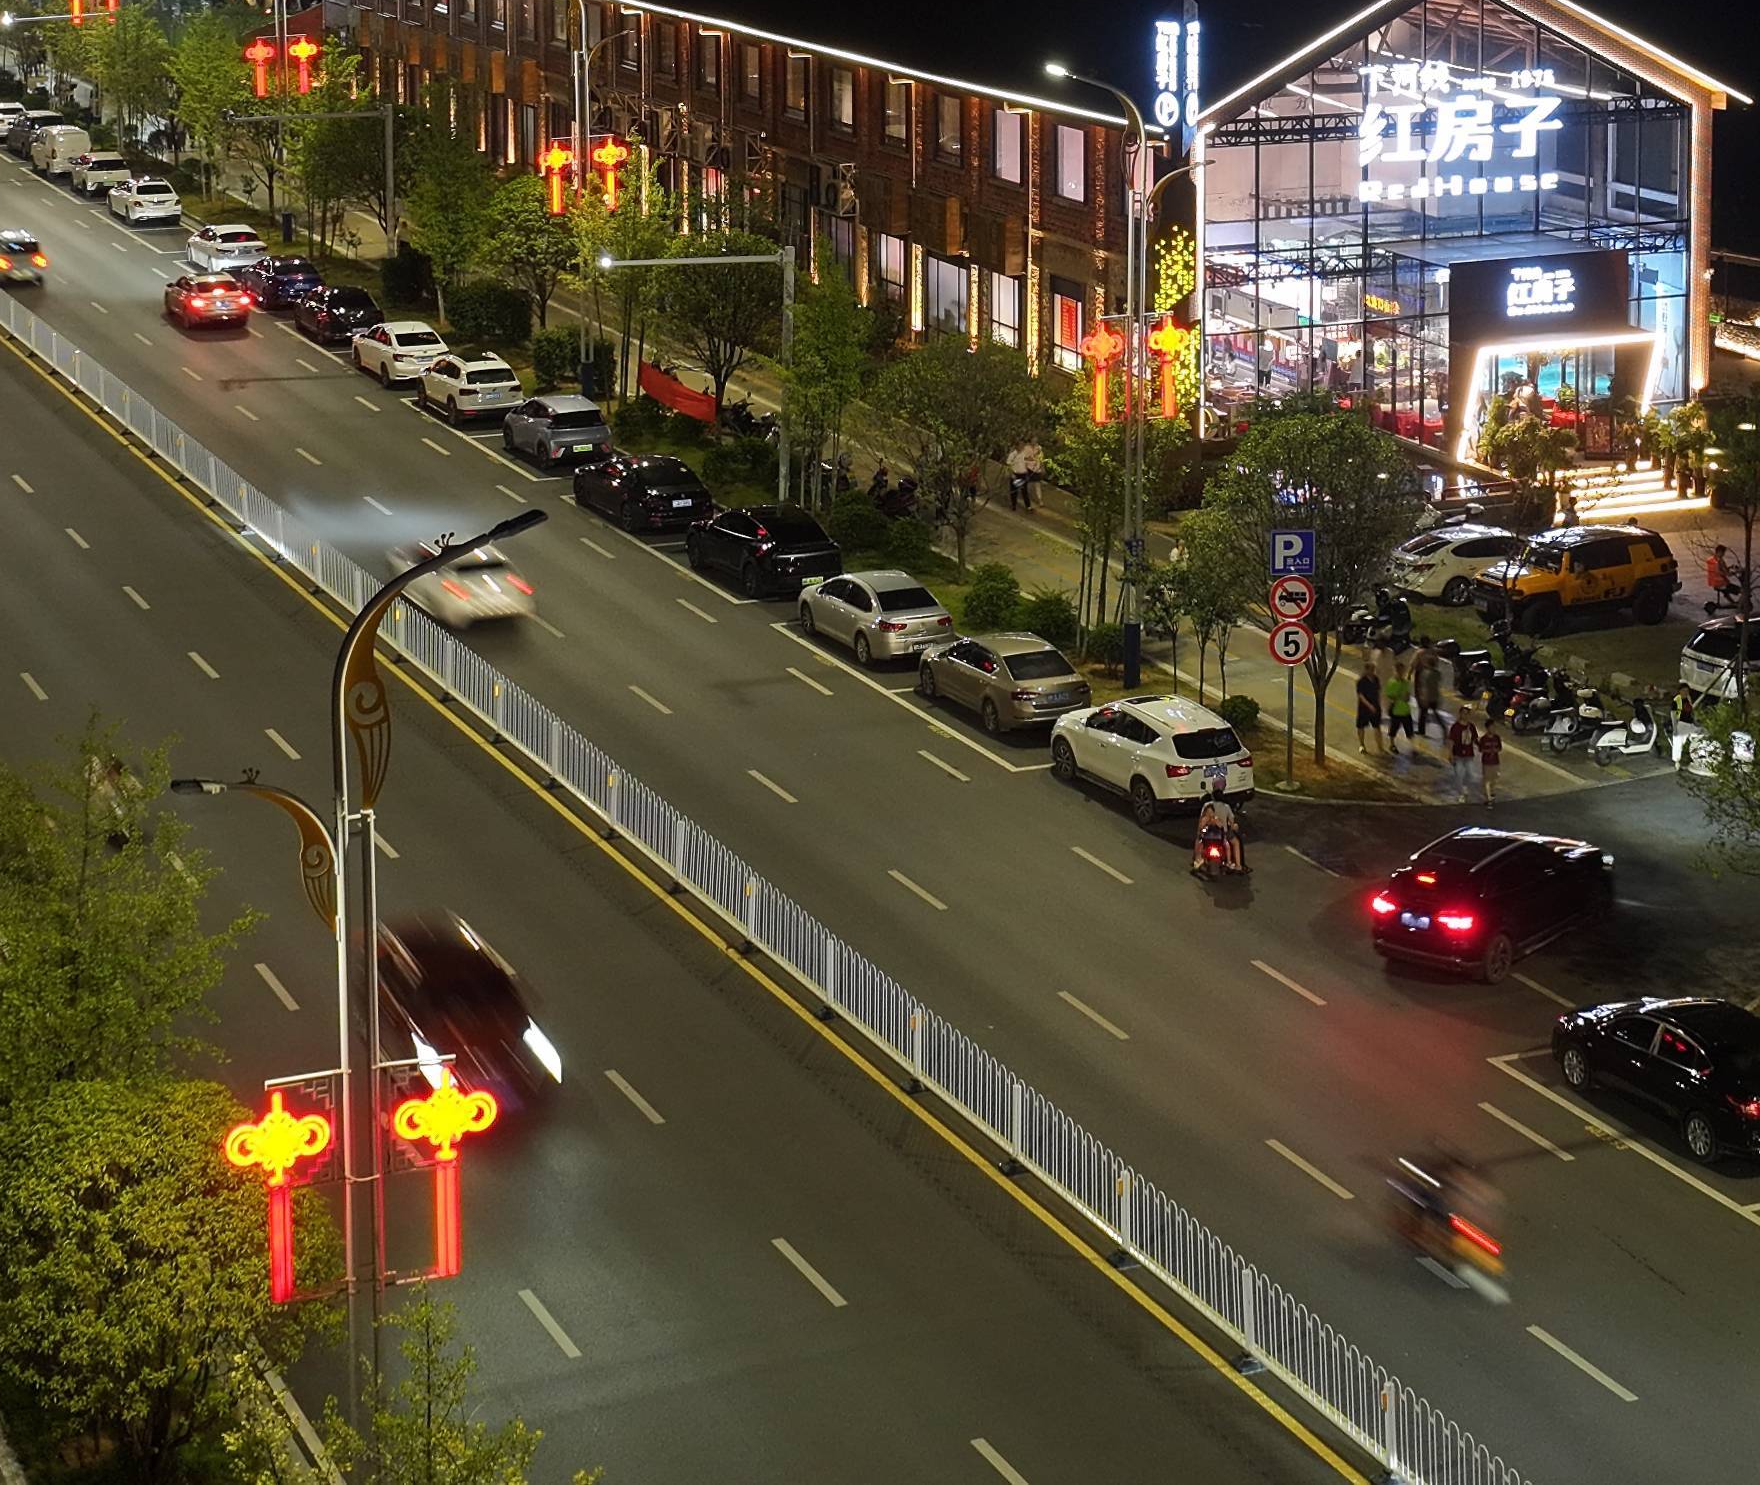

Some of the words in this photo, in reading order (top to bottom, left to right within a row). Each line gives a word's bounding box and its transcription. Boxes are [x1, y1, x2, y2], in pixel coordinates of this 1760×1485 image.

[1359, 95, 1563, 167] 红房子
[1275, 535, 1303, 569] P
[1283, 631, 1300, 657] 5
